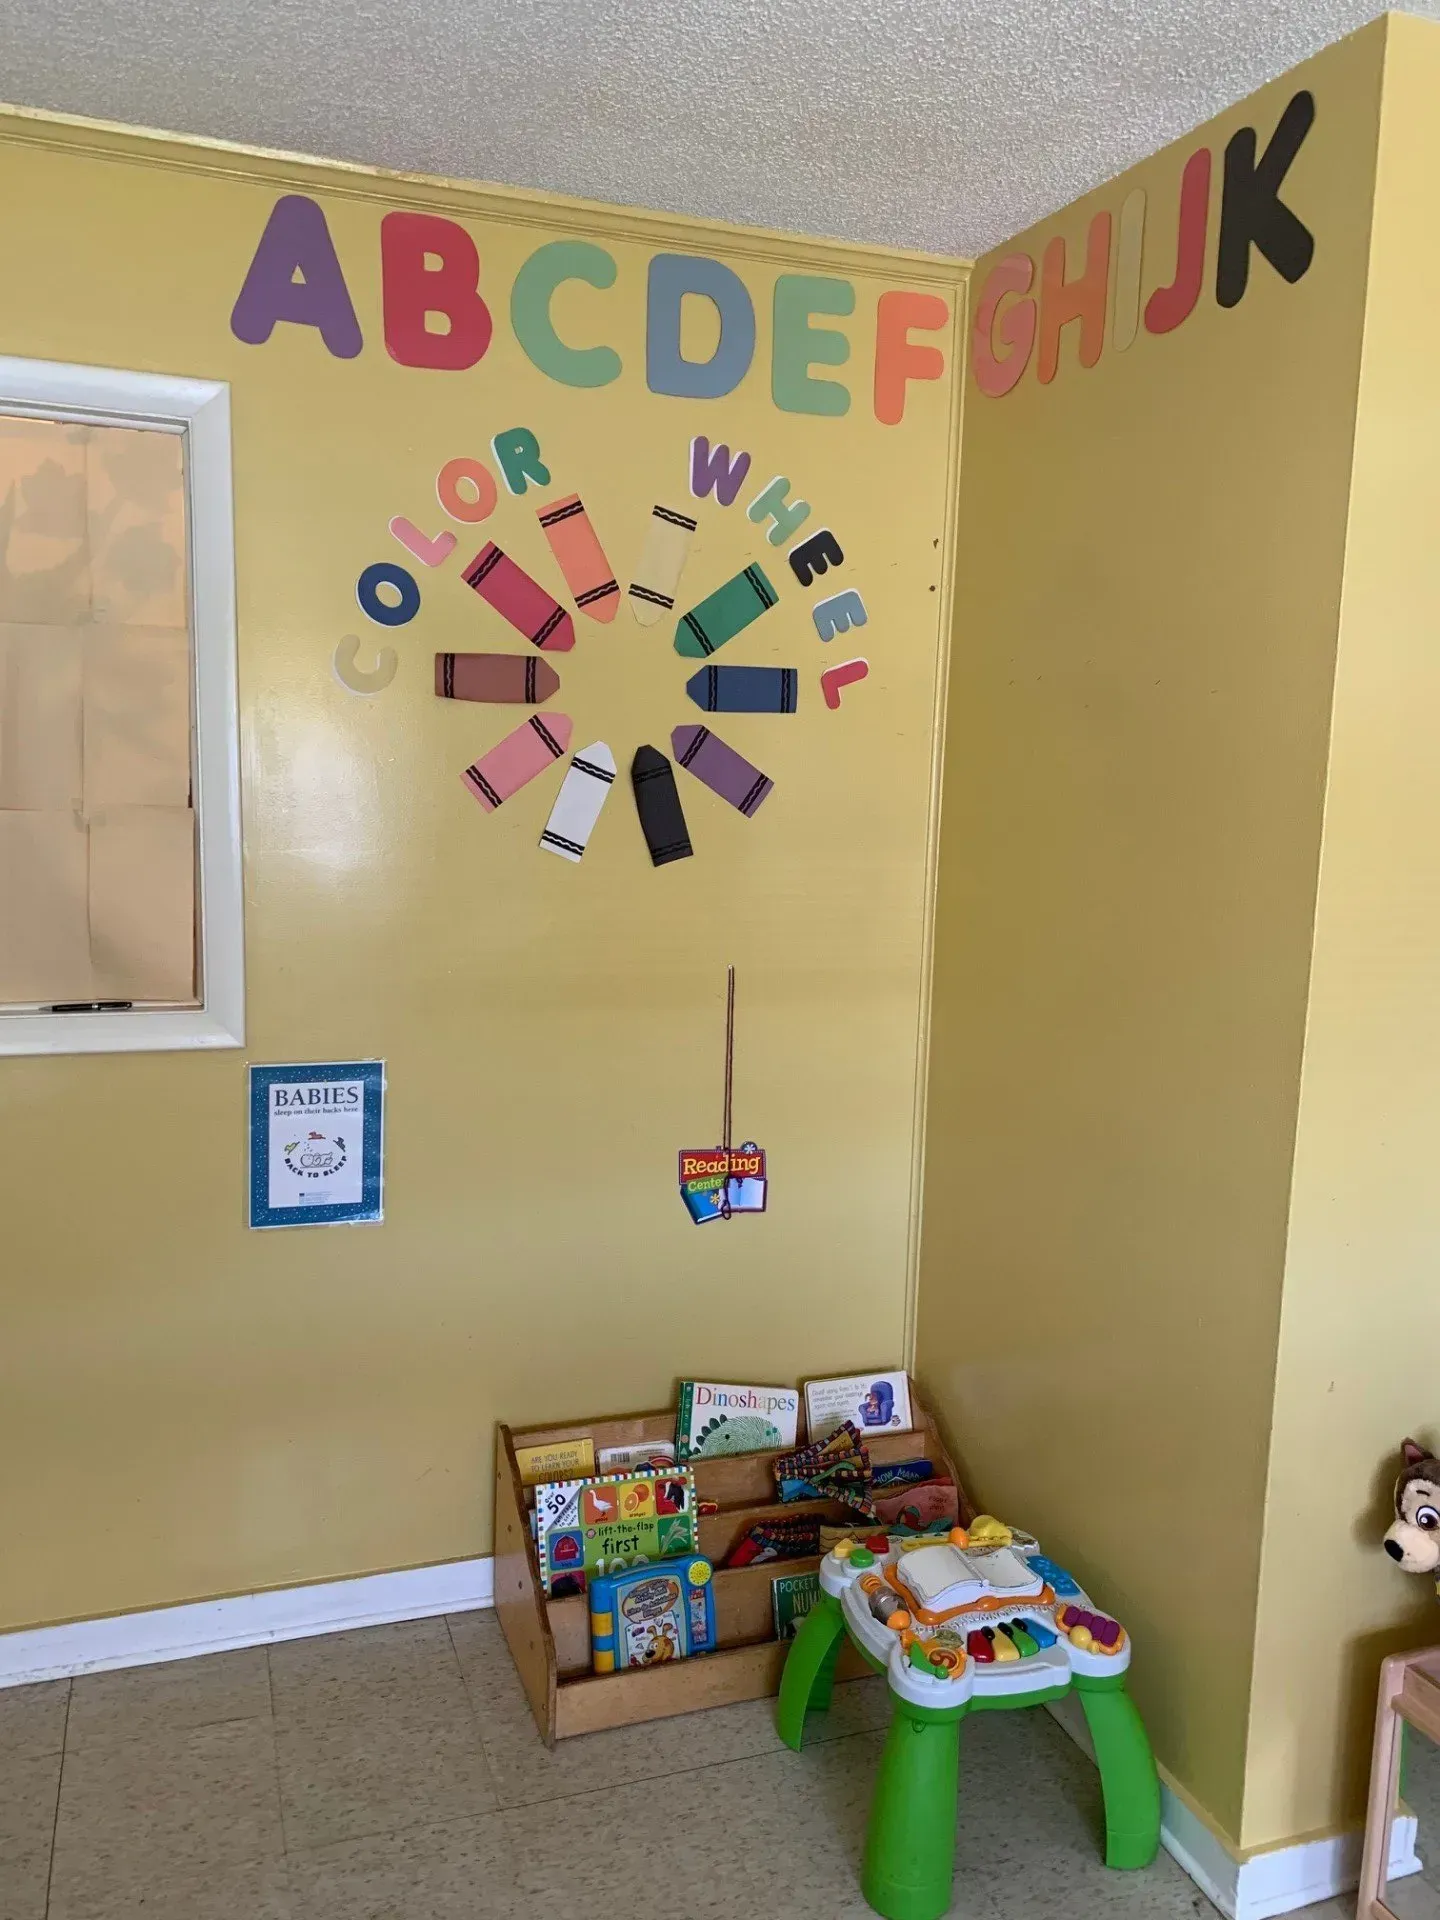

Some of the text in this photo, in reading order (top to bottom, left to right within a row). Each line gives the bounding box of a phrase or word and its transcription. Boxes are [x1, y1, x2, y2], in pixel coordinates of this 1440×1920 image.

[331, 427, 551, 696] COLOR
[690, 435, 869, 709] WHEEL
[274, 1086, 359, 1107] BABIES
[273, 1109, 292, 1117] sleep
[322, 1106, 342, 1114] backs
[284, 1158, 304, 1176] BACK
[323, 1155, 347, 1177] SLEEP
[683, 1152, 761, 1175] Reading
[695, 1386, 795, 1415] Dinoshapes
[530, 1450, 578, 1465] ARE YOU READY
[530, 1458, 580, 1473] TO LEARN YOUR
[547, 1494, 567, 1515] 50
[598, 1521, 654, 1537] lift-the-flap
[602, 1535, 640, 1555] first
[780, 1577, 815, 1594] POCKET
